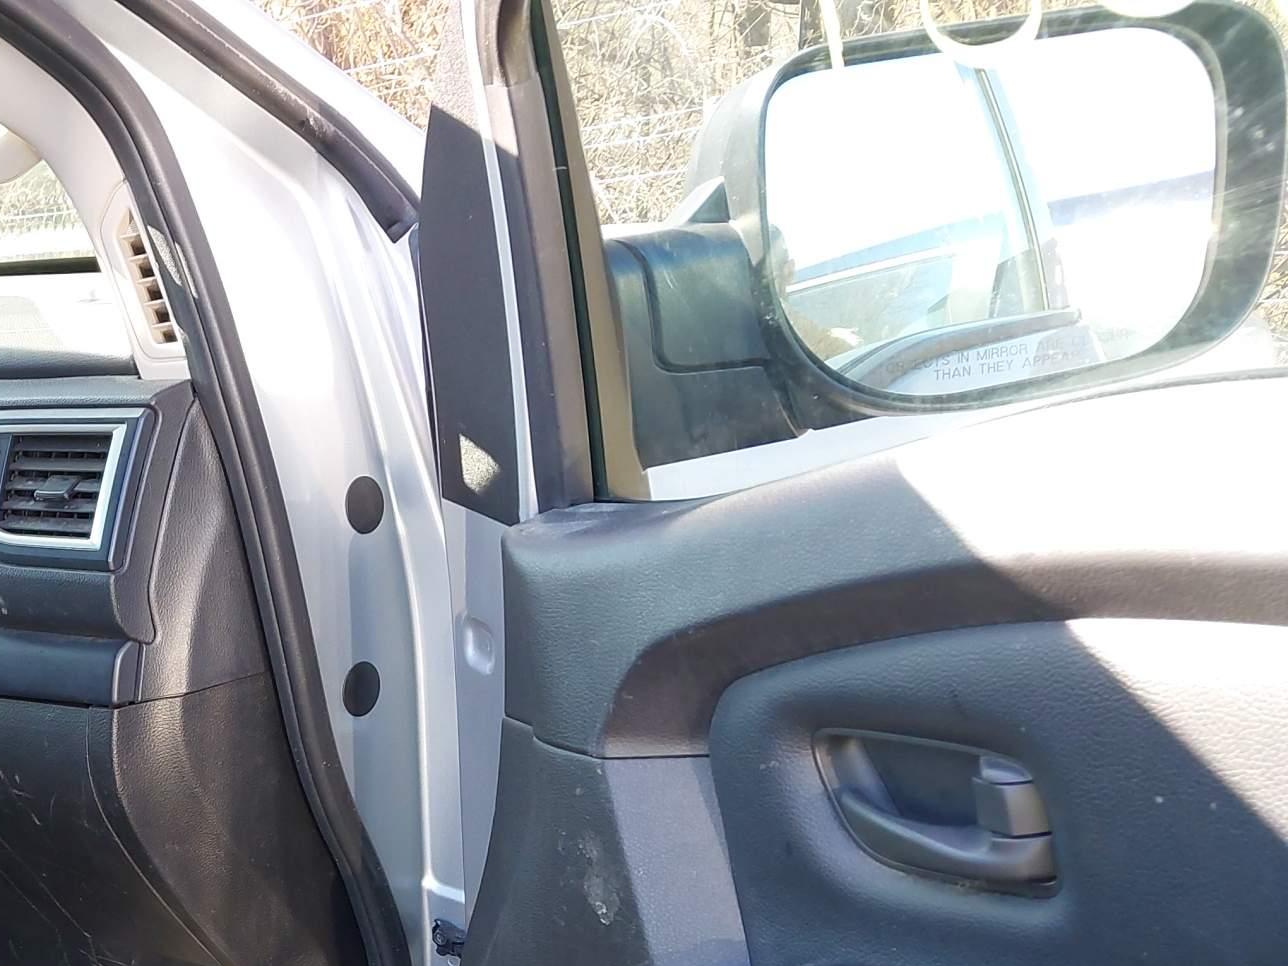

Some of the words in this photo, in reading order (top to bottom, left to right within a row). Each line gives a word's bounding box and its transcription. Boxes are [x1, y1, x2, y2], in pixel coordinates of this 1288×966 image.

[957, 351, 970, 365] IN
[976, 343, 1028, 361] MIRROR
[934, 366, 972, 381] THAN
[980, 359, 1013, 375] THEY
